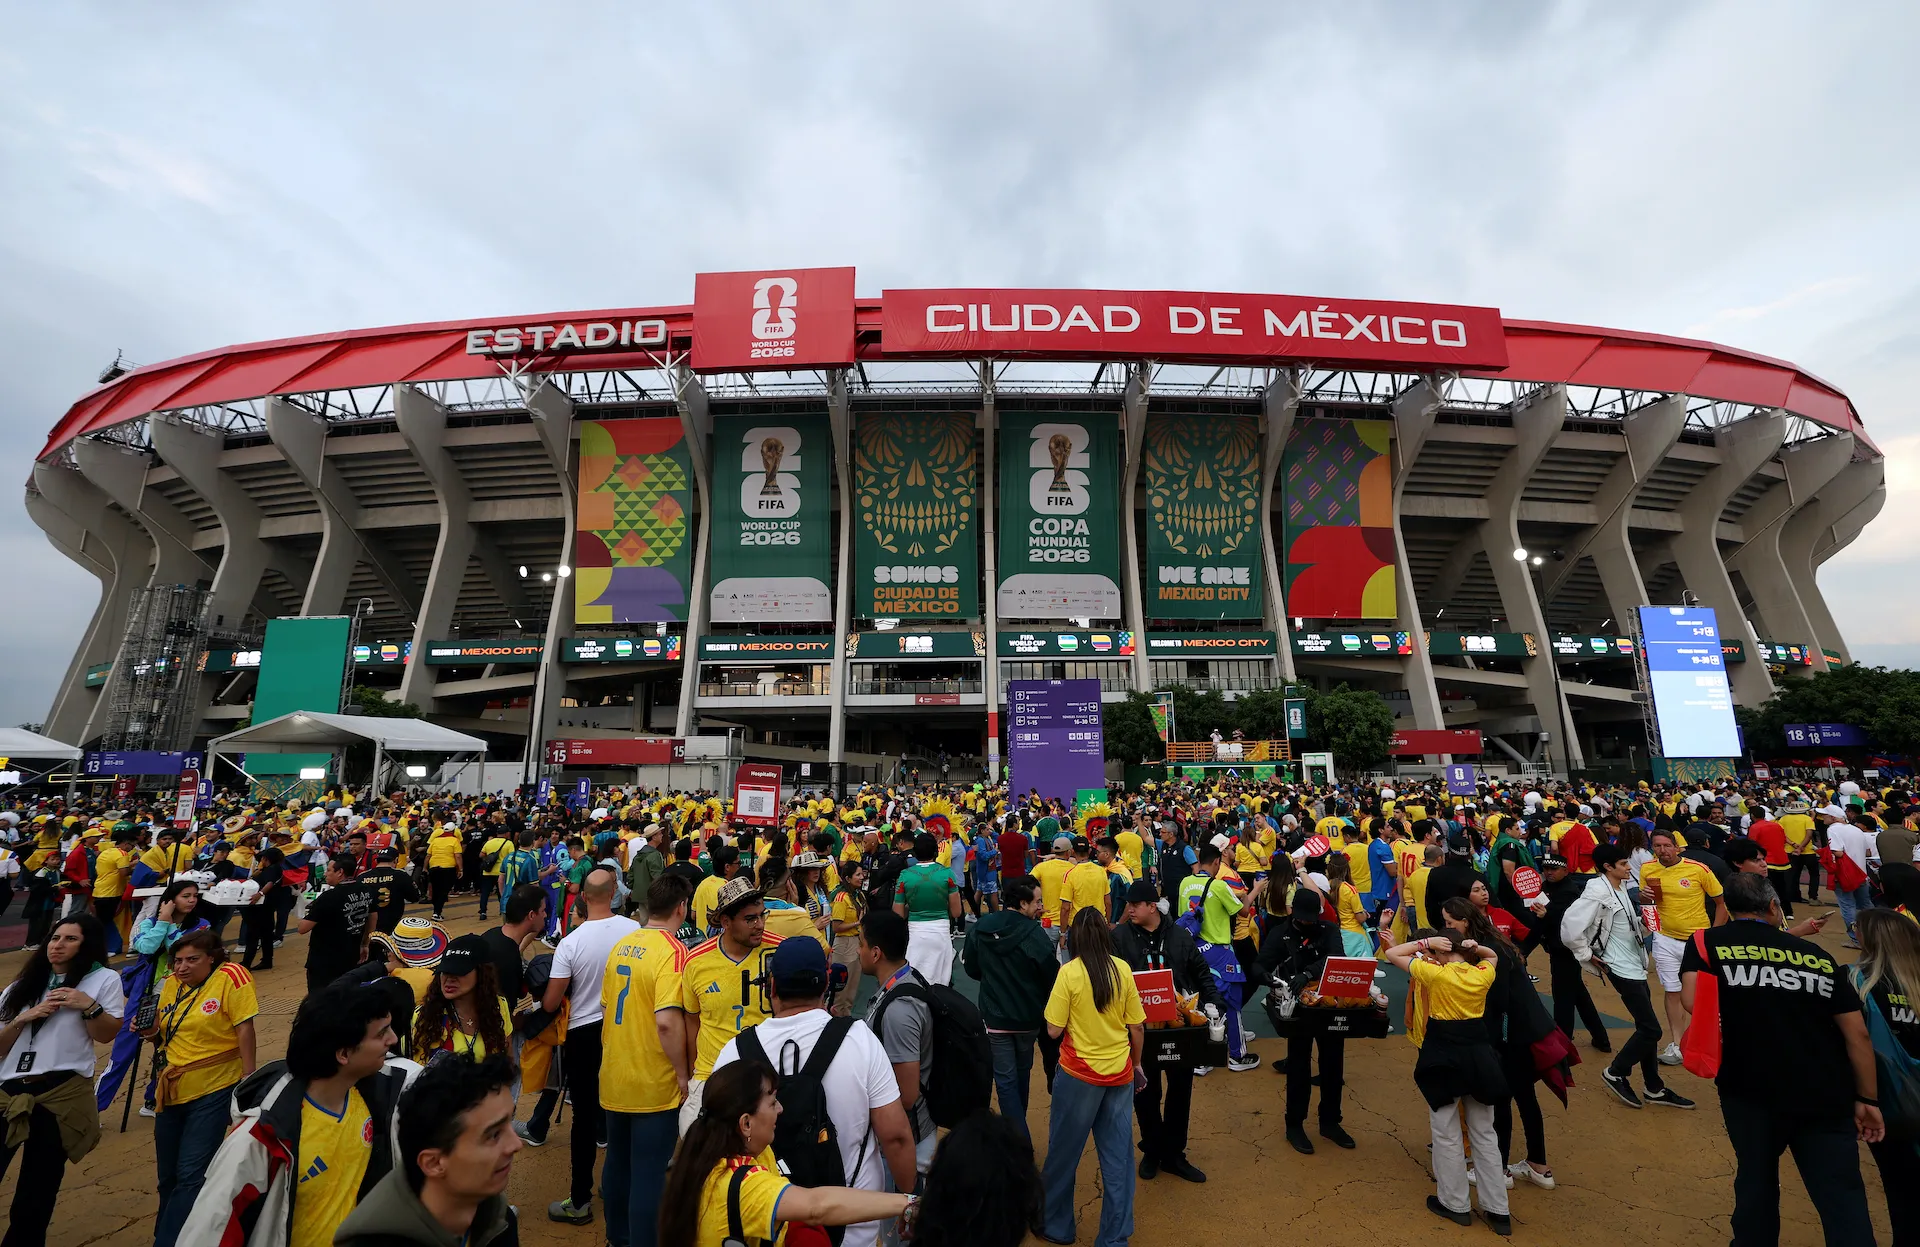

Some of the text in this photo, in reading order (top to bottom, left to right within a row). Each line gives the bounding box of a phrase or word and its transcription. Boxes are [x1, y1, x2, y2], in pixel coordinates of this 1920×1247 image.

[926, 304, 1467, 348] CIUDAD DE MÉXICO
[466, 320, 668, 356] ESTADIO
[751, 340, 795, 348] WORLD CUP
[750, 348, 795, 358] 2026
[758, 500, 785, 509] FIFA
[1047, 496, 1074, 506] FIFA
[741, 521, 801, 531] WORLD CUP
[1029, 518, 1090, 536] COPA
[740, 532, 801, 546] 2026
[1029, 536, 1090, 548] MUNDIAL
[1029, 549, 1090, 563] 2026
[874, 565, 959, 584] SOMOS
[1159, 565, 1250, 585] WE ARE
[874, 587, 959, 599] CIUDAD DE
[1158, 587, 1250, 600] MEXICO CITY
[873, 599, 960, 613] MÉXICO
[739, 643, 794, 651] MEXICO
[796, 642, 829, 650] CITY
[1183, 639, 1236, 647] MEXICO
[1238, 639, 1269, 647] CITY
[461, 647, 511, 656] MEXICO
[1788, 730, 1804, 741] 18
[1808, 732, 1821, 744] 18
[552, 749, 567, 763] 15
[674, 745, 685, 757] 15
[87, 761, 100, 772] 13
[183, 757, 199, 768] 13
[1326, 825, 1339, 838] 10
[1402, 851, 1416, 877] 10
[361, 875, 394, 884] JOSE LUIS
[377, 887, 391, 908] 3
[617, 944, 632, 957] LUIS
[1715, 945, 1834, 974] RESIDUOS
[1327, 975, 1361, 985] $240
[1722, 965, 1835, 999] WASTE
[615, 964, 631, 1025] 7
[732, 1004, 744, 1031] 7
[1161, 1042, 1176, 1050] FRIES
[1157, 1053, 1181, 1062] BONELESS
